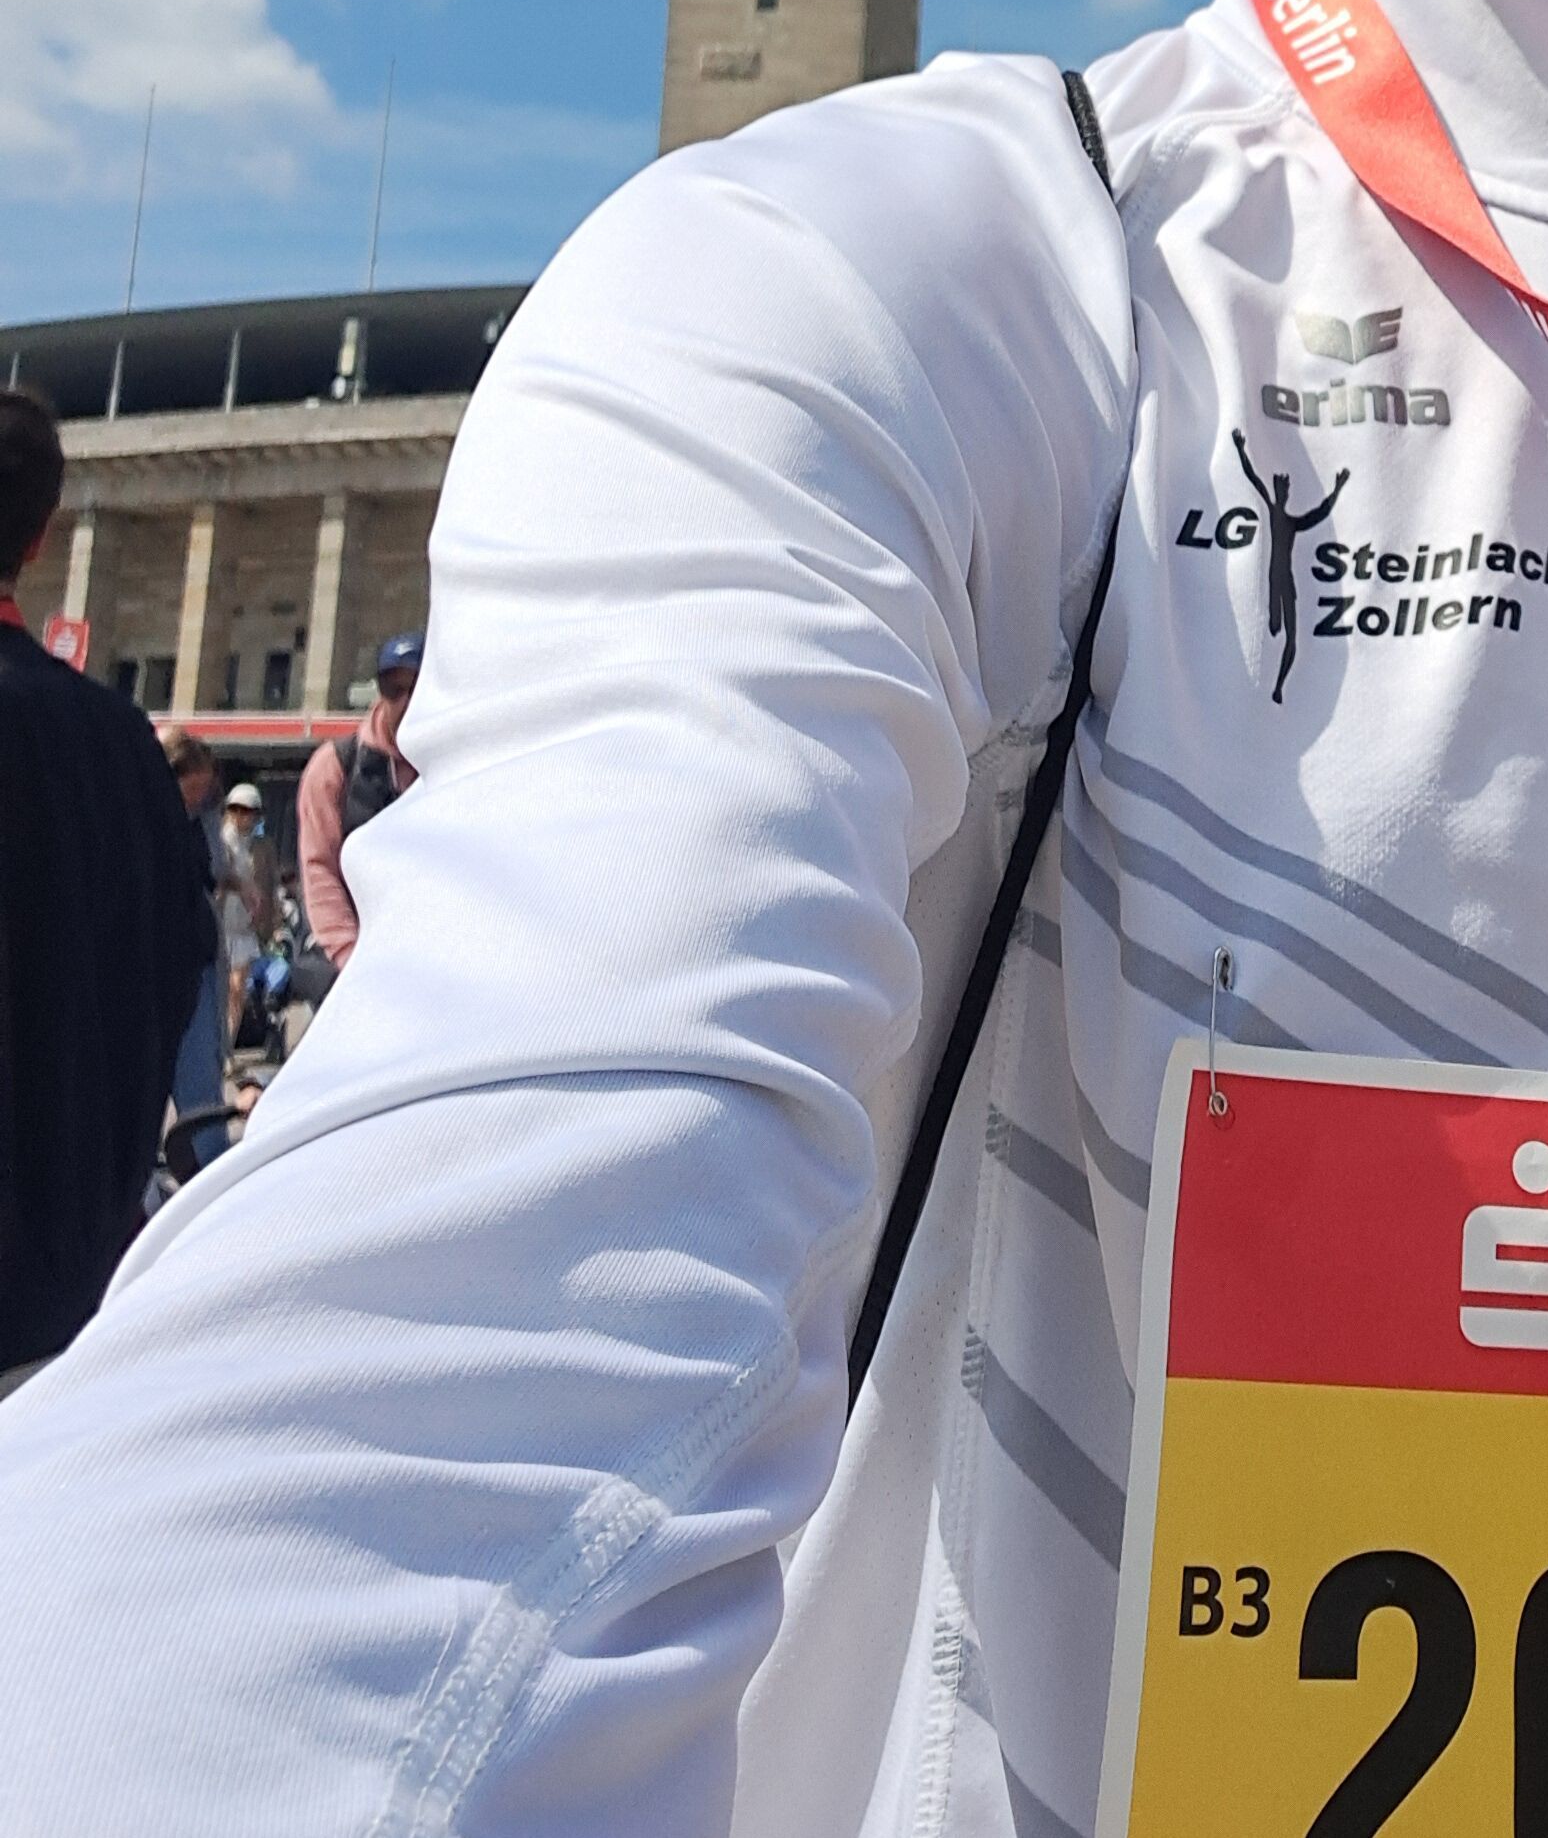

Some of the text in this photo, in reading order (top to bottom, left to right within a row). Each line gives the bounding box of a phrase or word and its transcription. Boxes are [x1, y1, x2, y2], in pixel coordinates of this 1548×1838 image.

[1260, 377, 1452, 428] erima
[1174, 506, 1260, 550] LG
[1312, 594, 1523, 638] Zollern
[1179, 1565, 1272, 1638] B3
